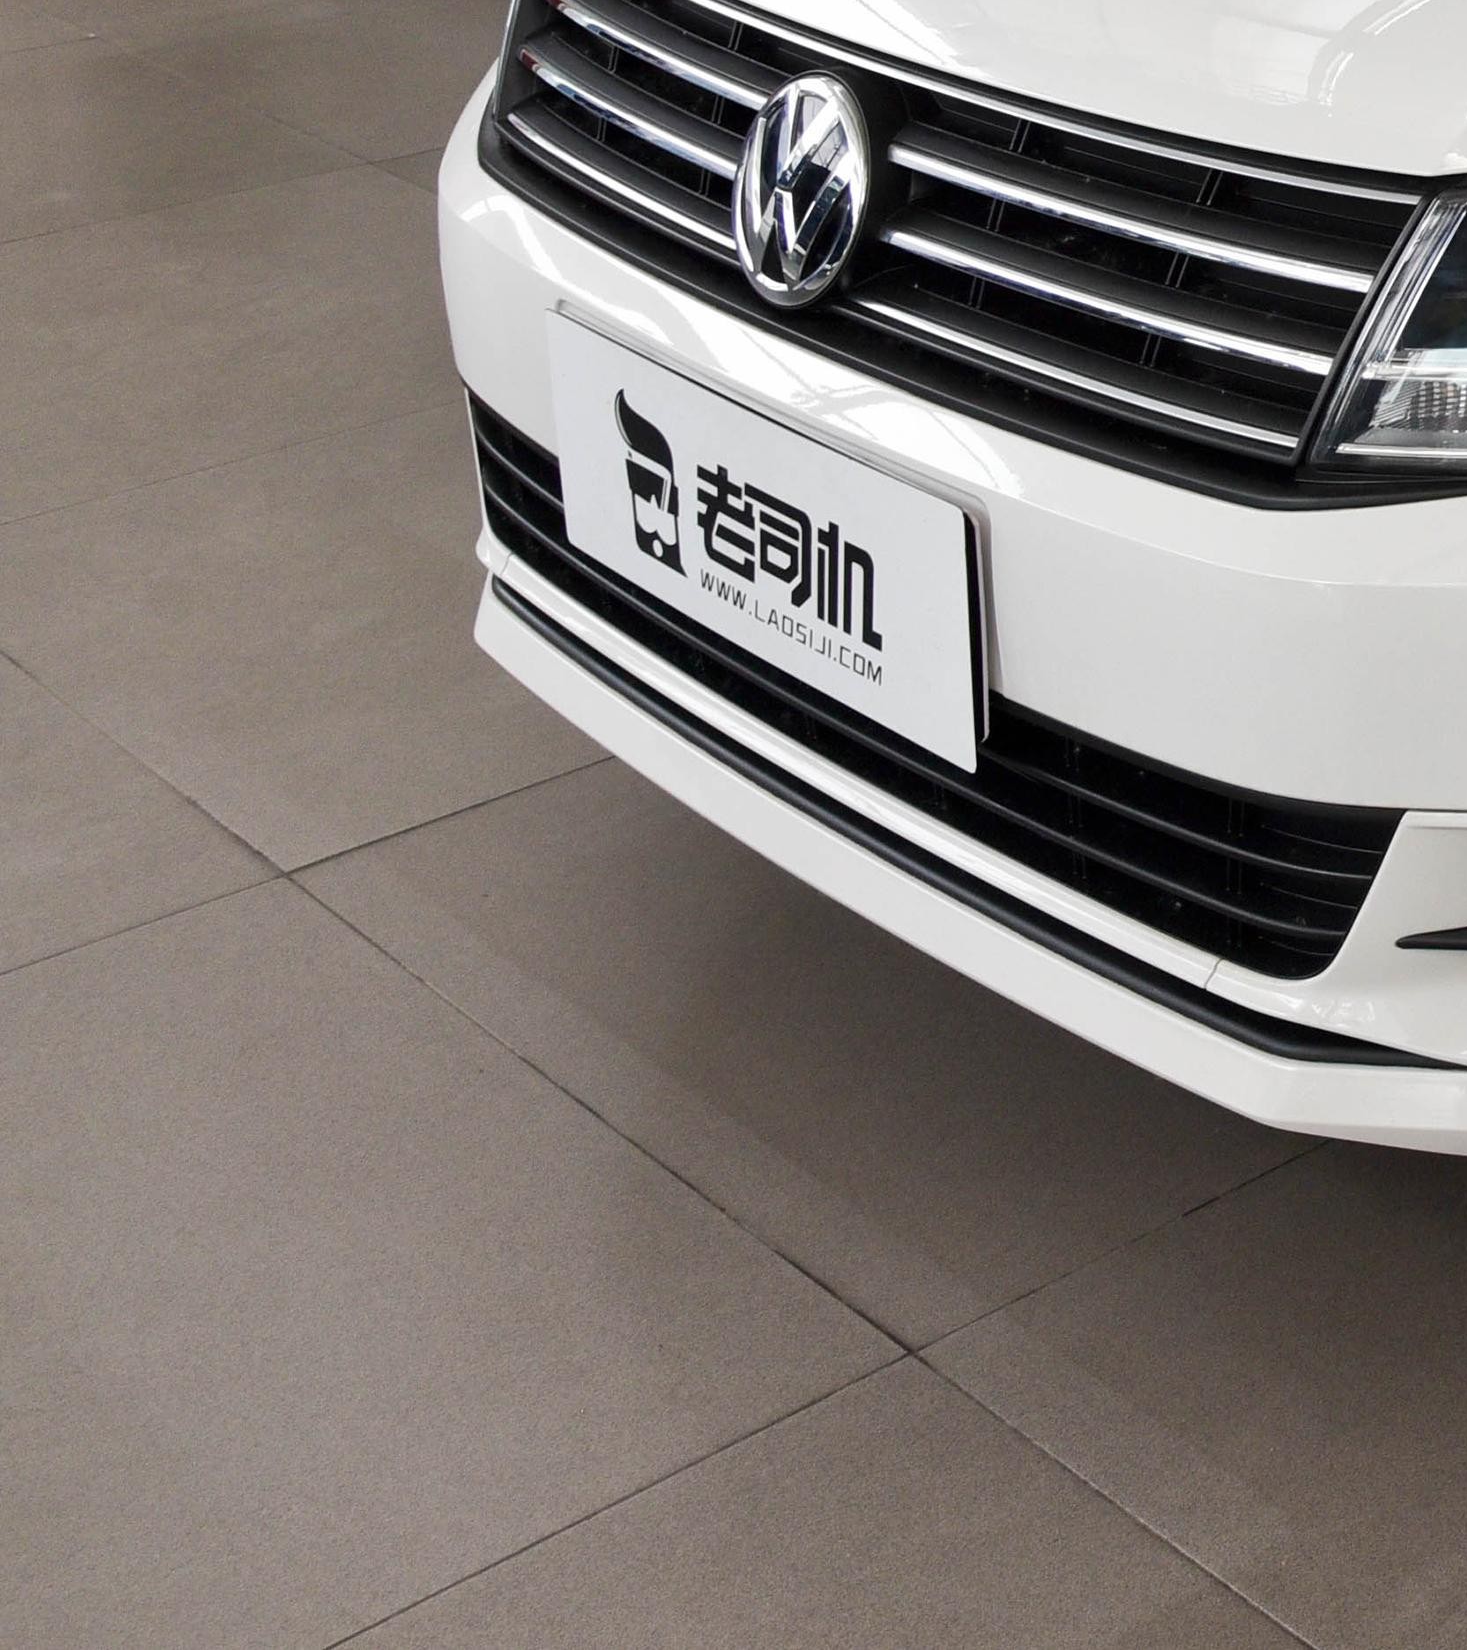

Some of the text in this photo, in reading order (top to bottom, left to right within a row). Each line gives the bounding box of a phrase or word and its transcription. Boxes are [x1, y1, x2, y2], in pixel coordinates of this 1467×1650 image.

[697, 464, 883, 652] 老司机
[700, 567, 883, 687] WWW.LAOSIJI.COM
